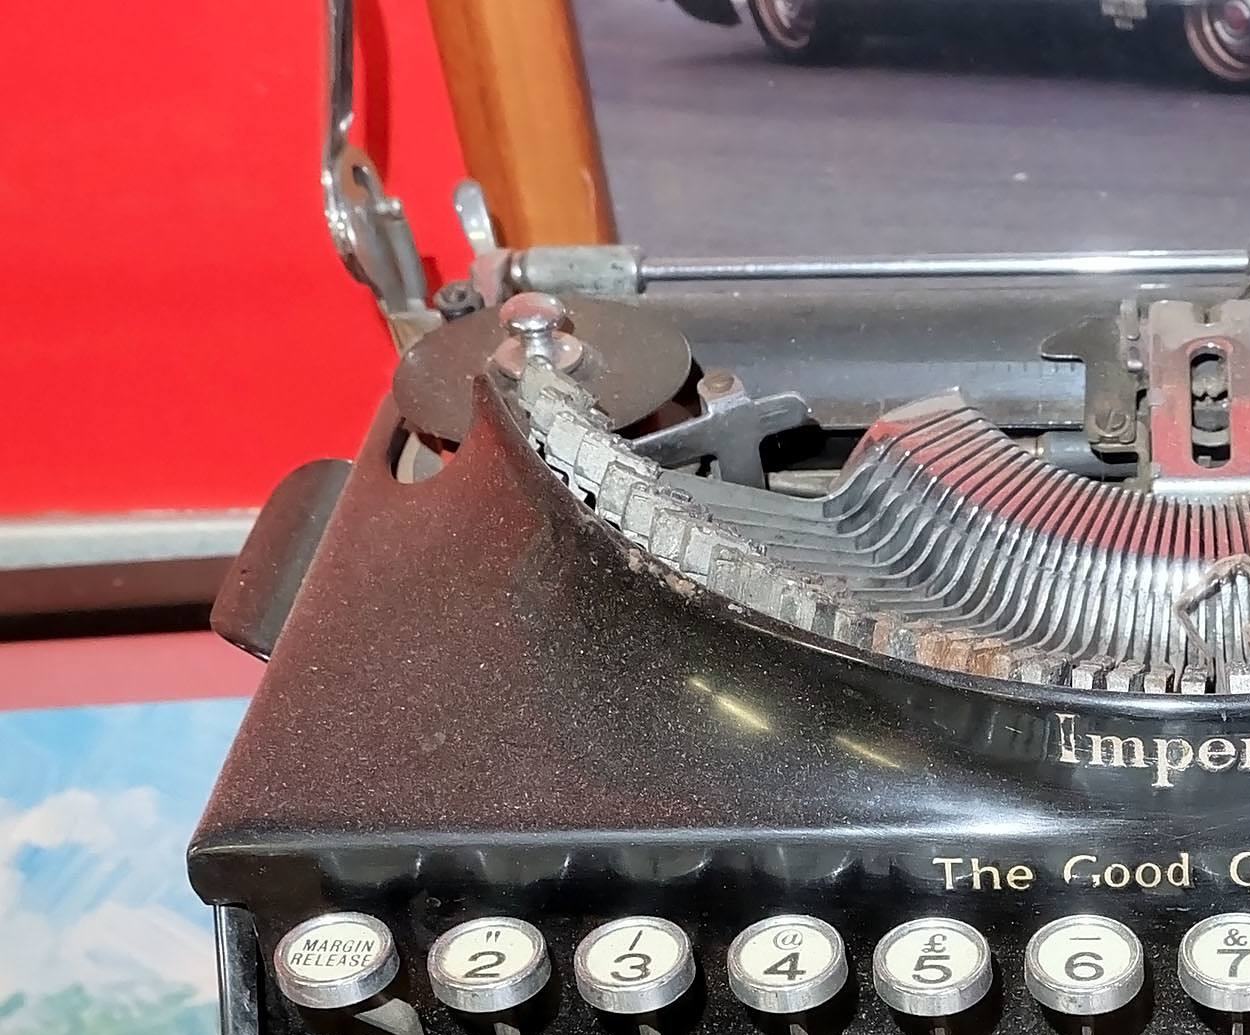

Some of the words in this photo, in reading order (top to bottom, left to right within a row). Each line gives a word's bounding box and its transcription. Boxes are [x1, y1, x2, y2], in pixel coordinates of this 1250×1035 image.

[933, 857, 1033, 891] The
[1063, 853, 1191, 889] Good
[302, 939, 375, 953] MARGIN
[773, 929, 803, 949] @
[921, 934, 946, 954] £
[1223, 929, 1247, 946] &
[290, 953, 373, 967] RELEASE
[465, 951, 505, 979] 2
[610, 953, 652, 982] 3
[763, 952, 806, 981] 4
[912, 955, 952, 984] 5
[1064, 952, 1104, 981] 6
